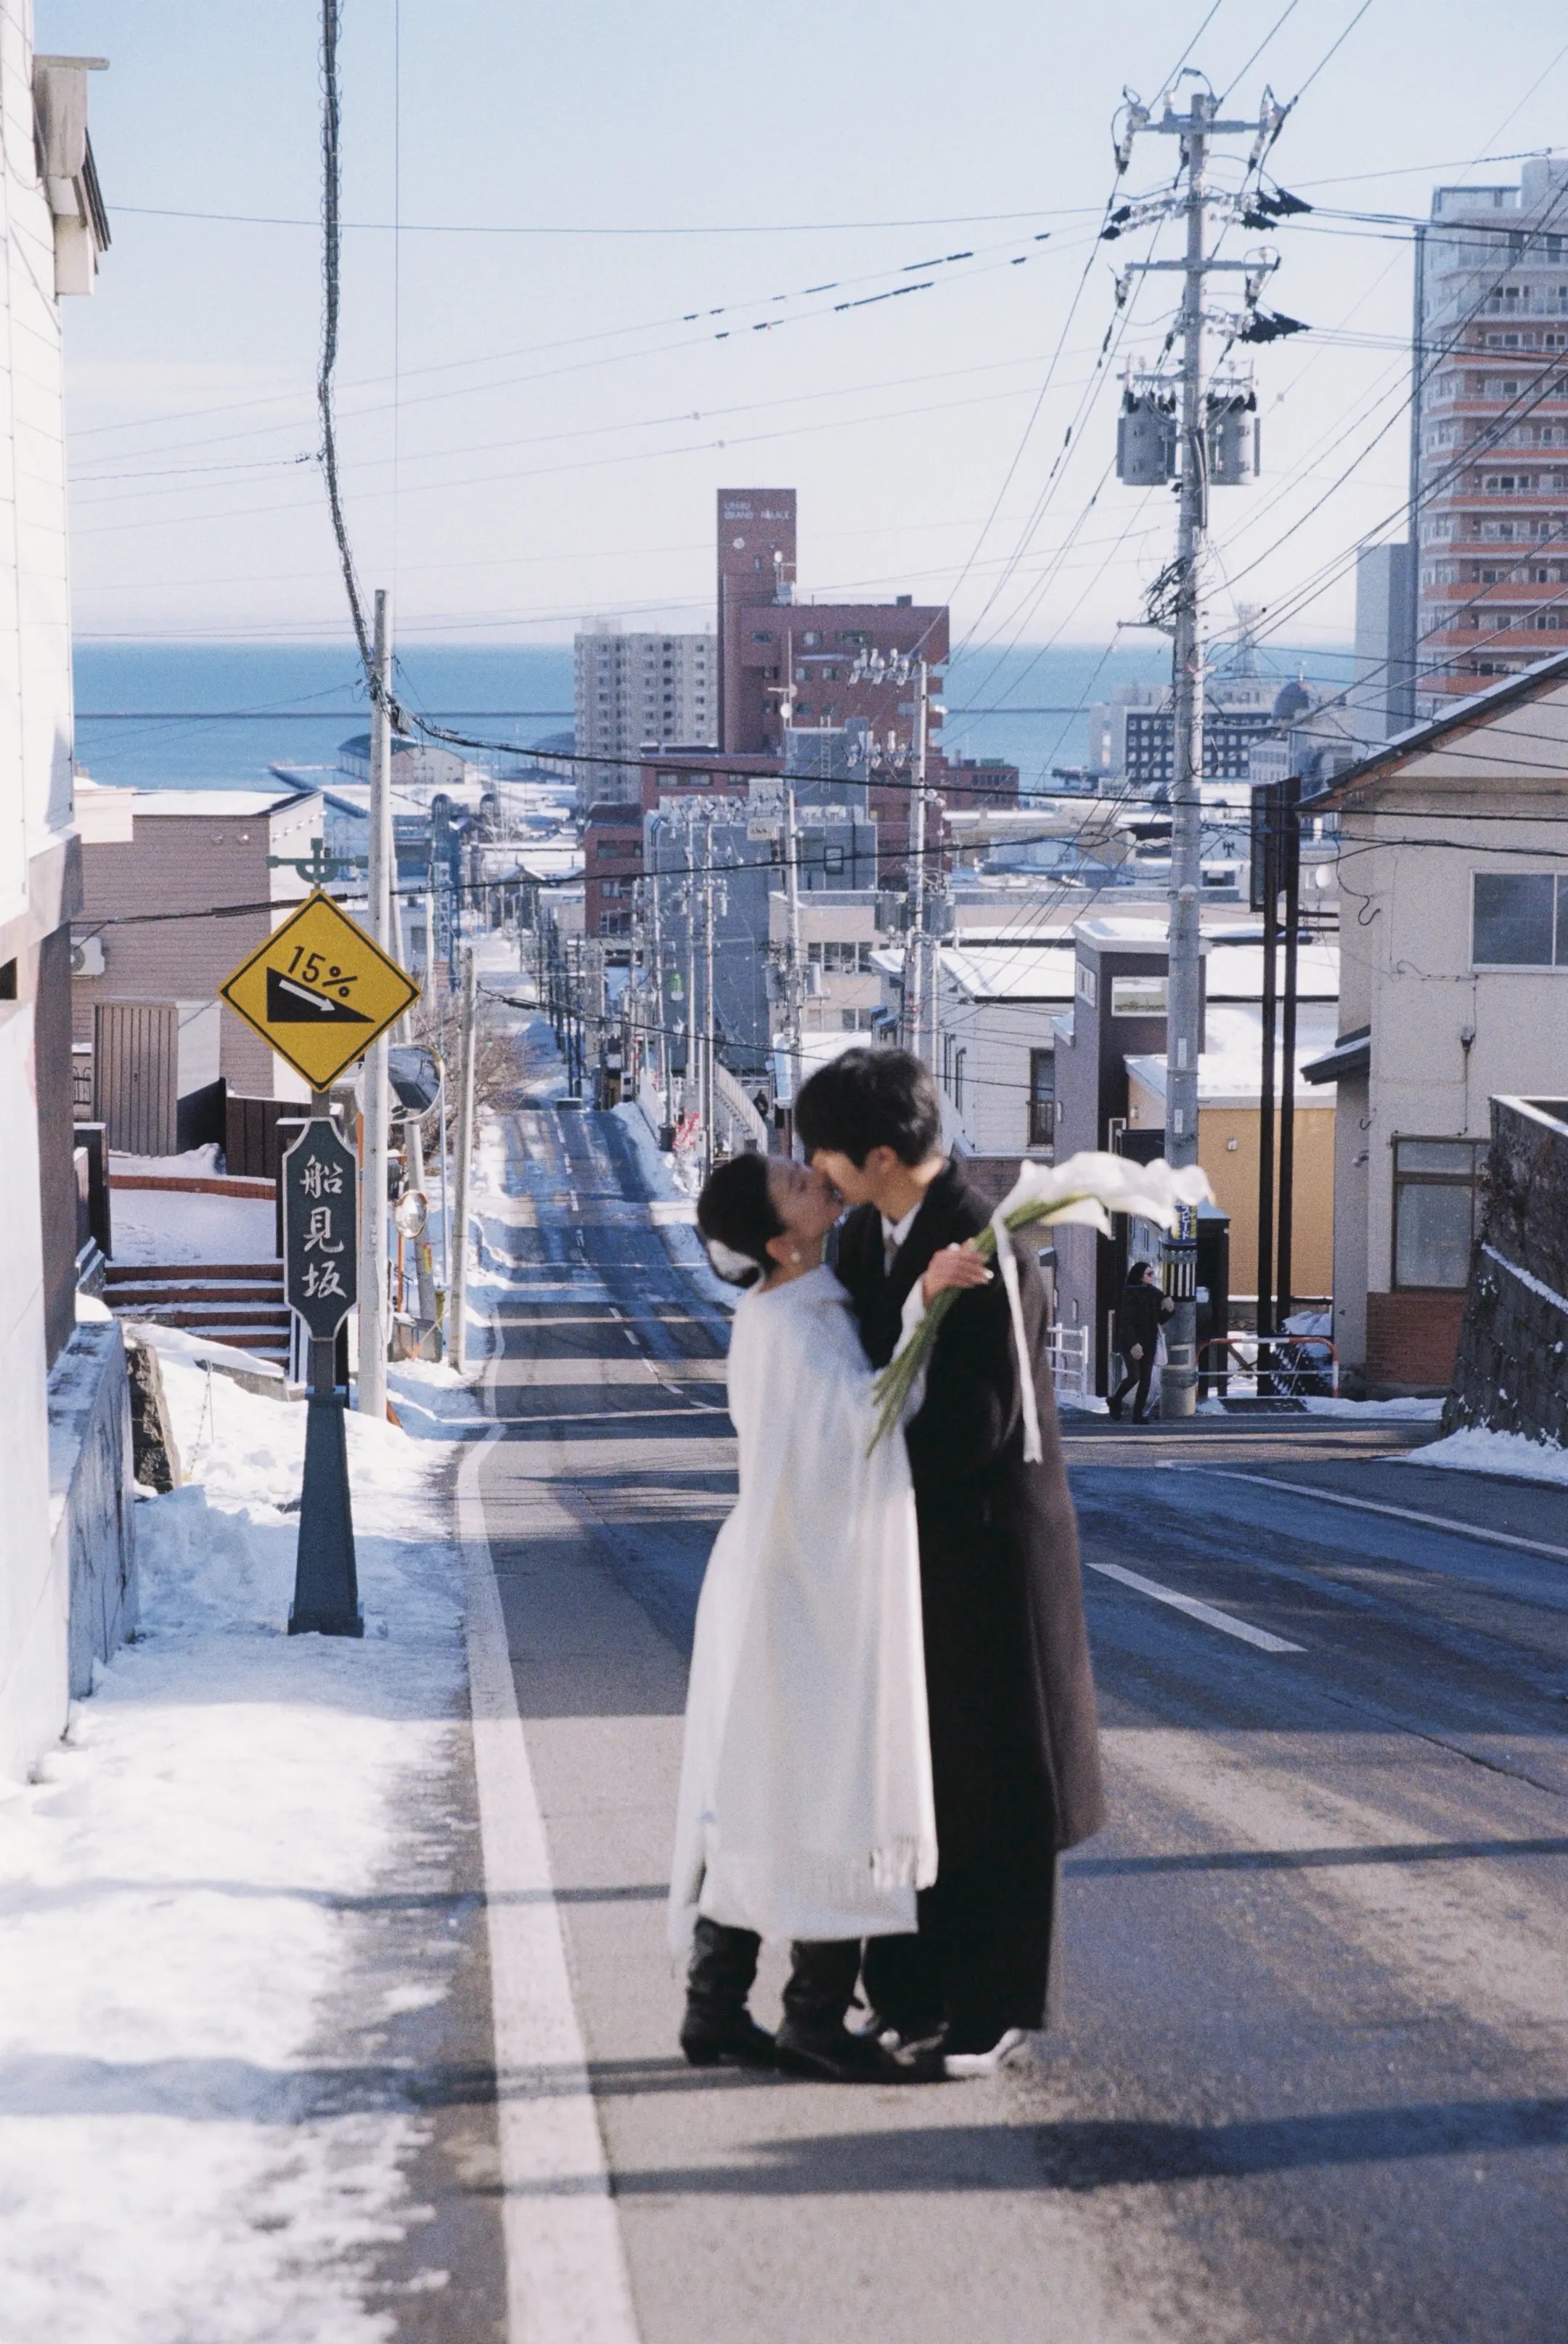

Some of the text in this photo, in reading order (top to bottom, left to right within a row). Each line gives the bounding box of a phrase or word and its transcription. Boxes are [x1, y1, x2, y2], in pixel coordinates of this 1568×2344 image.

[287, 945, 358, 998] 15%
[299, 1154, 347, 1299] 船見坂
